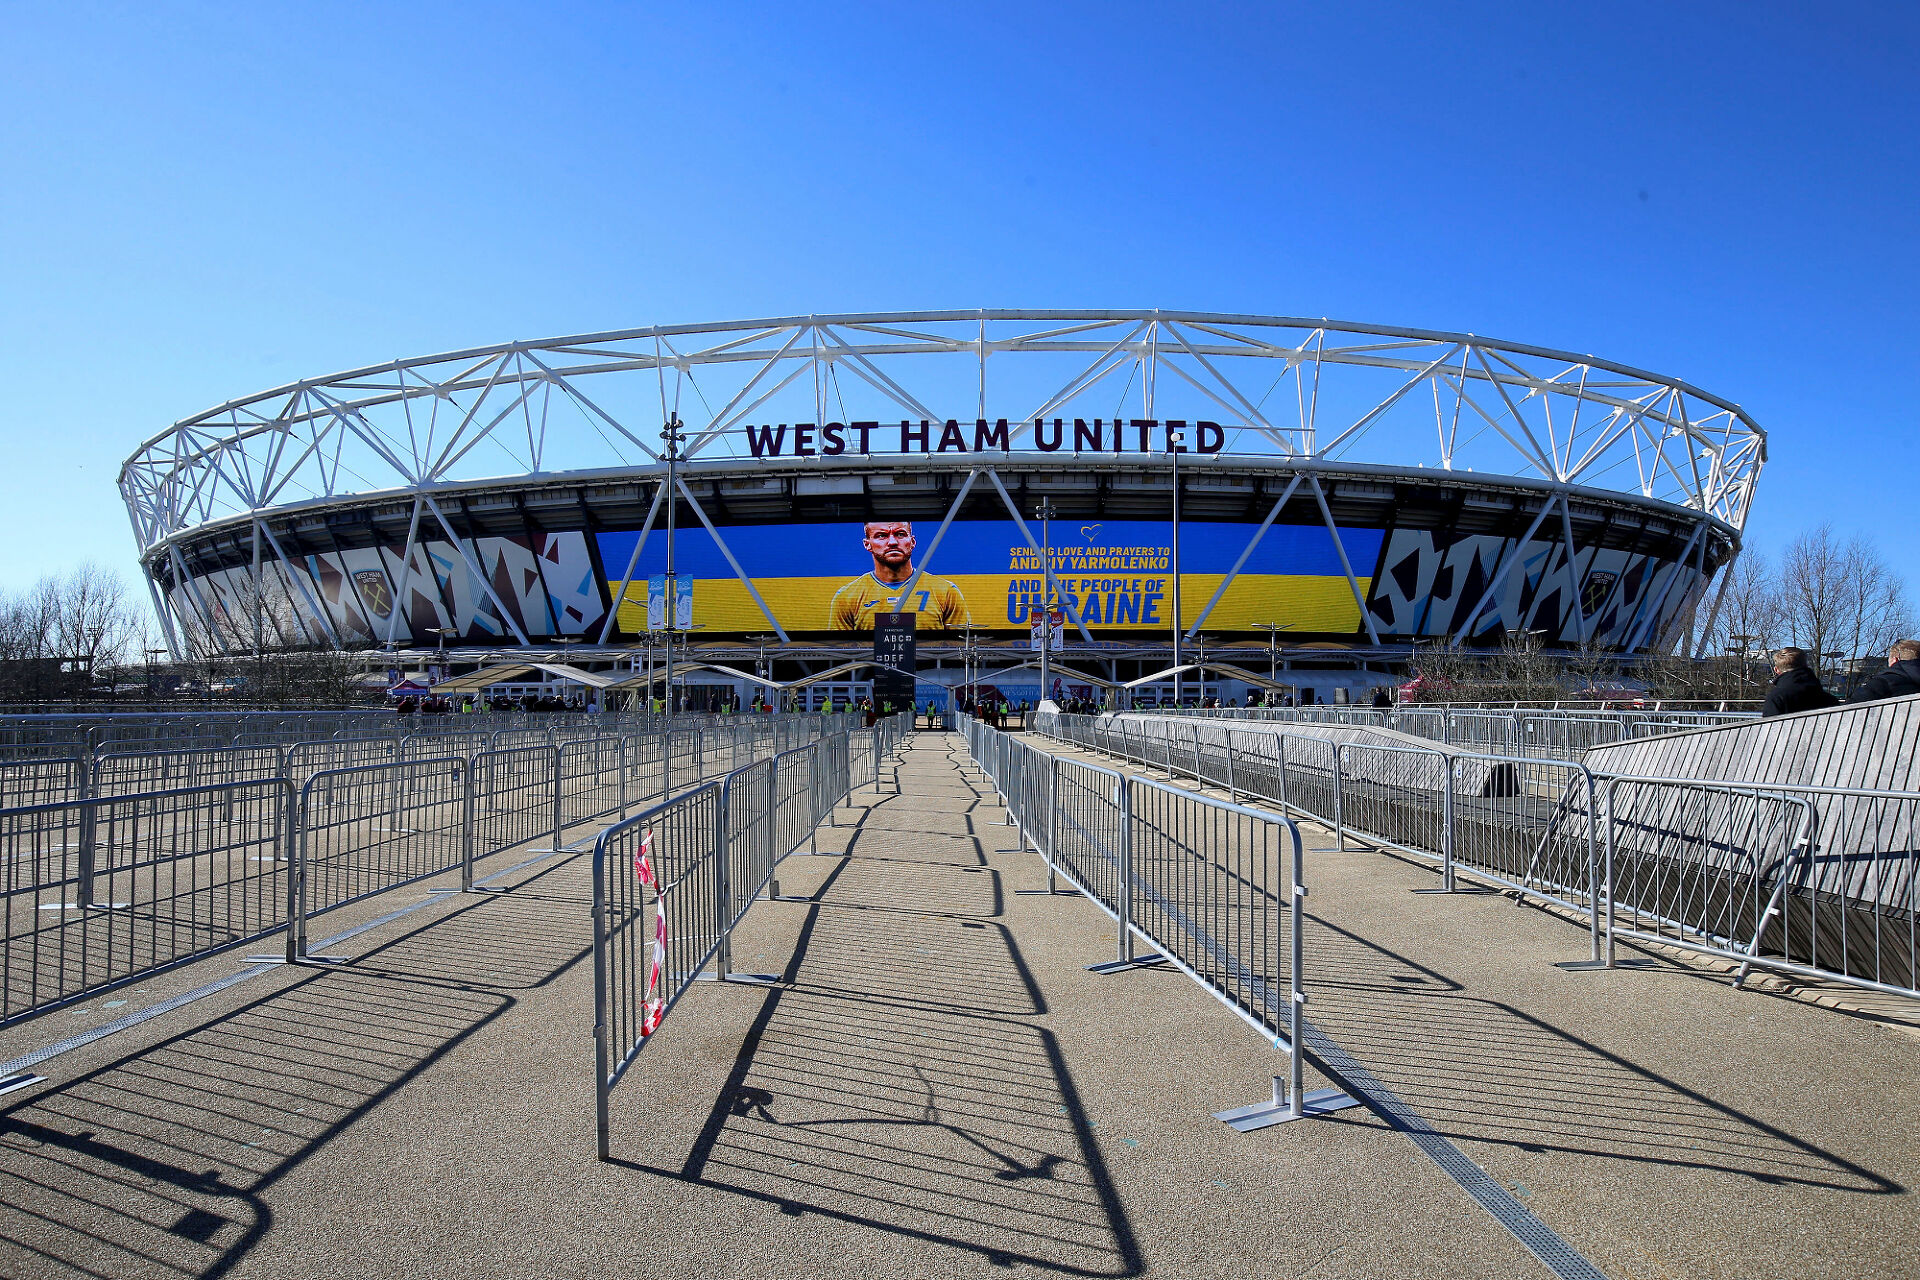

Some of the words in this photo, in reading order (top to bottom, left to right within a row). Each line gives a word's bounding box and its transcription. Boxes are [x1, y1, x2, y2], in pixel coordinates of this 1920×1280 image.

[746, 421, 879, 457] WEST
[901, 418, 1010, 453] HAM
[1034, 418, 1225, 453] UNITED
[1010, 547, 1055, 557] SENDG
[1058, 547, 1083, 556] LOVE
[1086, 547, 1106, 556] AND
[1109, 547, 1154, 556] PRAYERS
[1158, 547, 1170, 556] TO
[1010, 557, 1066, 569] ANDIY
[1070, 556, 1169, 569] YARMOLENKO
[1008, 579, 1042, 593] AND
[1081, 579, 1141, 592] PEOPLE
[1145, 579, 1166, 592] OF
